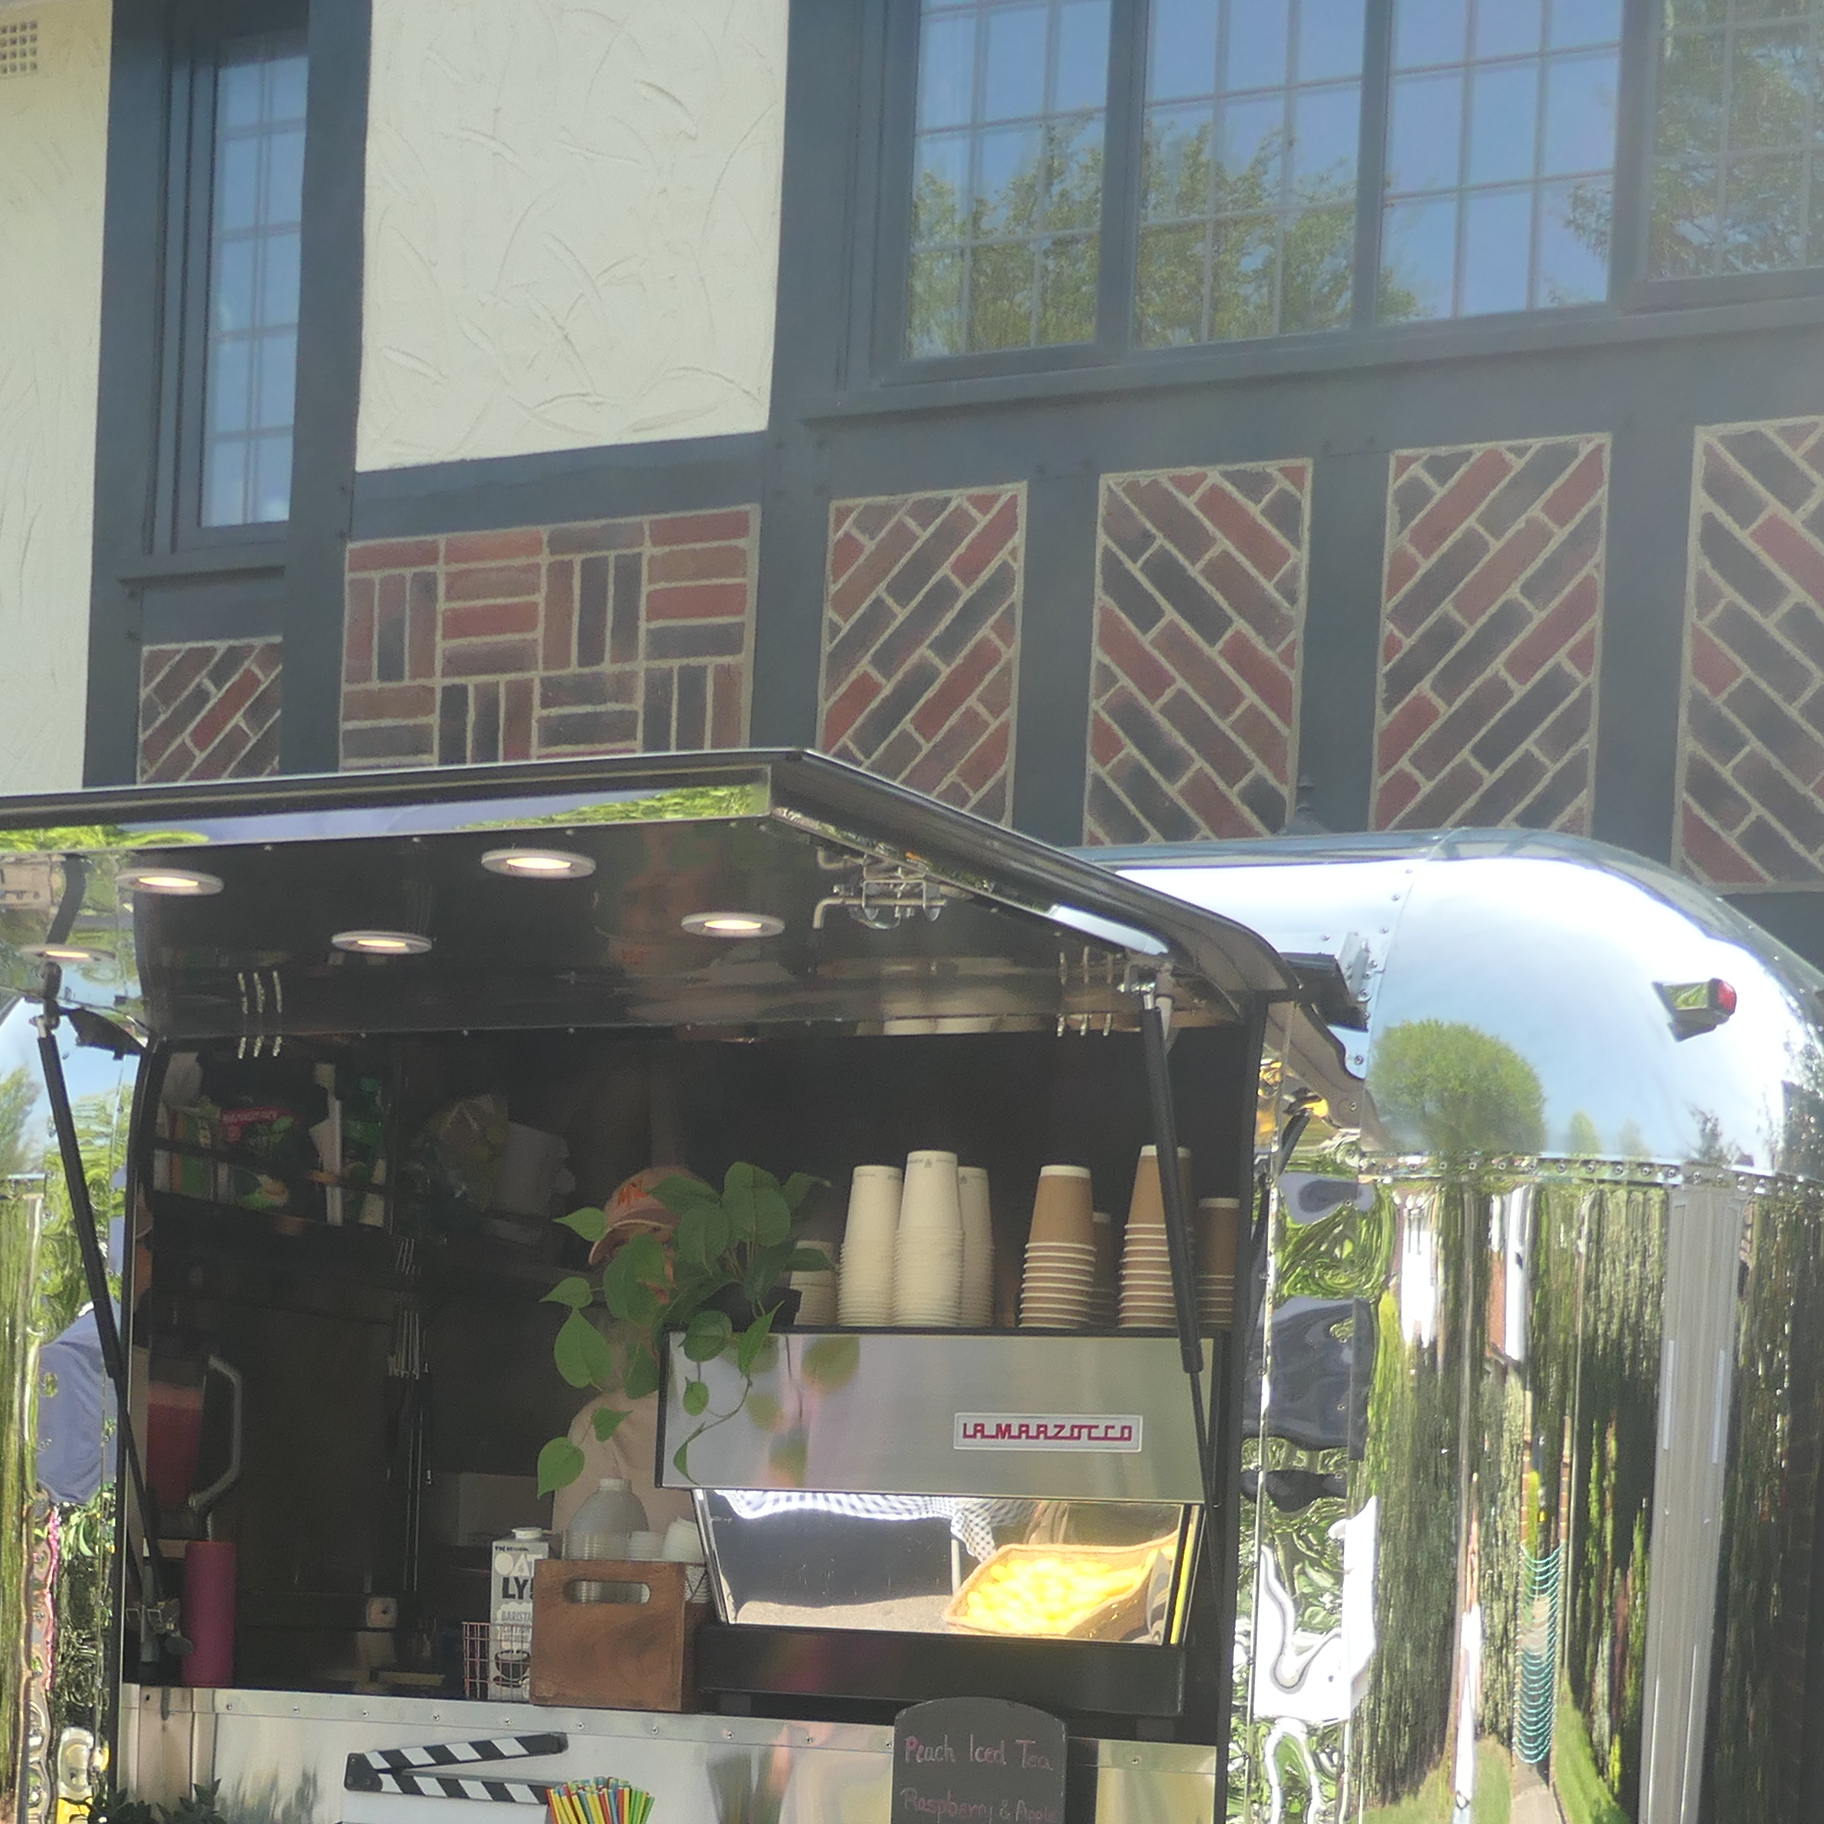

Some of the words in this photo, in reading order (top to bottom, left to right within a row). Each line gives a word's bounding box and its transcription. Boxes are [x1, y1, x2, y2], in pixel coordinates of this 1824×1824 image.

[962, 1422, 986, 1440] LA
[905, 1733, 956, 1764] Peach
[969, 1733, 1007, 1766] Iced
